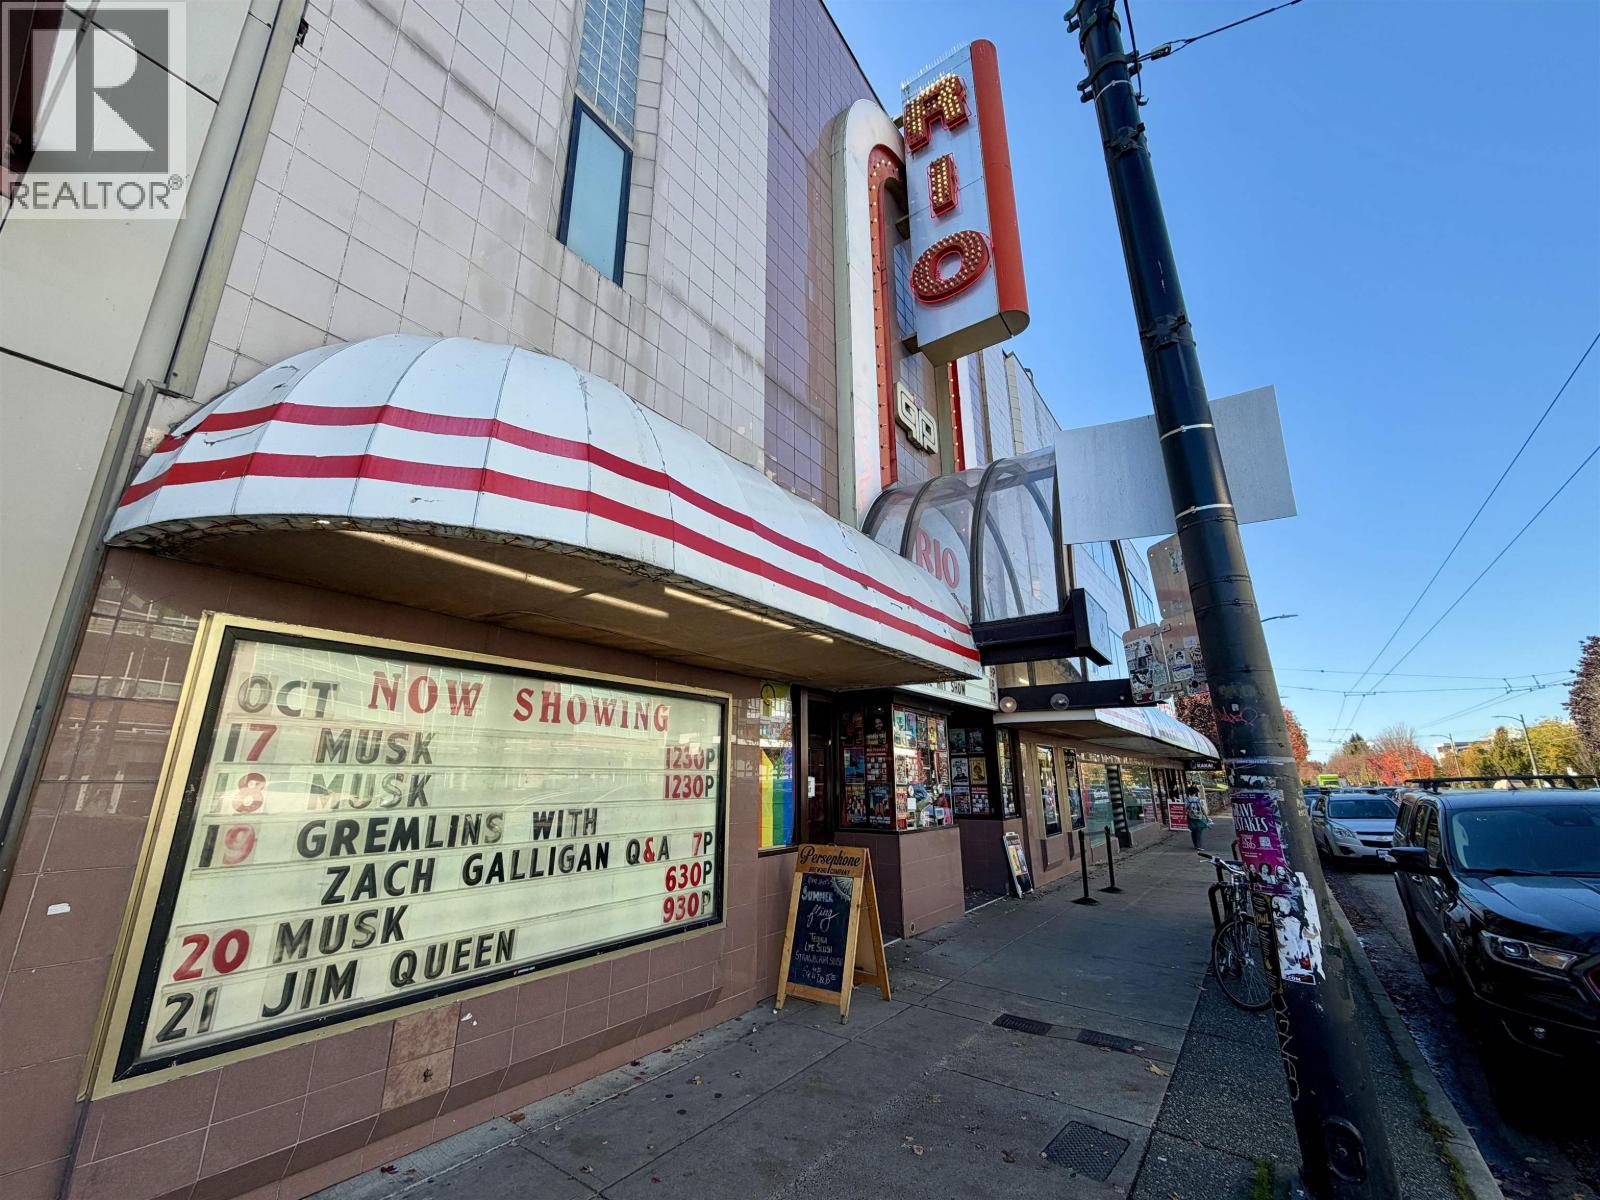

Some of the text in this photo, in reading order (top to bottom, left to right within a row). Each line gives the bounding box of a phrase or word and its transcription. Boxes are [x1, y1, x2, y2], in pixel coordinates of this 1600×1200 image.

[903, 72, 994, 304] RIO
[914, 527, 960, 590] RIO
[236, 670, 670, 732] OCT NOW SHOWING
[223, 723, 717, 771] 17 MUSK 1230P
[214, 773, 716, 815] 18 MUSK 1230P
[199, 807, 599, 869] 19 GREMLINS WITH
[320, 831, 714, 905] ZACH GALLIGAN Q&A 7P
[800, 845, 861, 873] Persephone
[173, 860, 714, 983] 20 MUSK 630P
[155, 890, 713, 1043] 21 JIM QUEEN 930P
